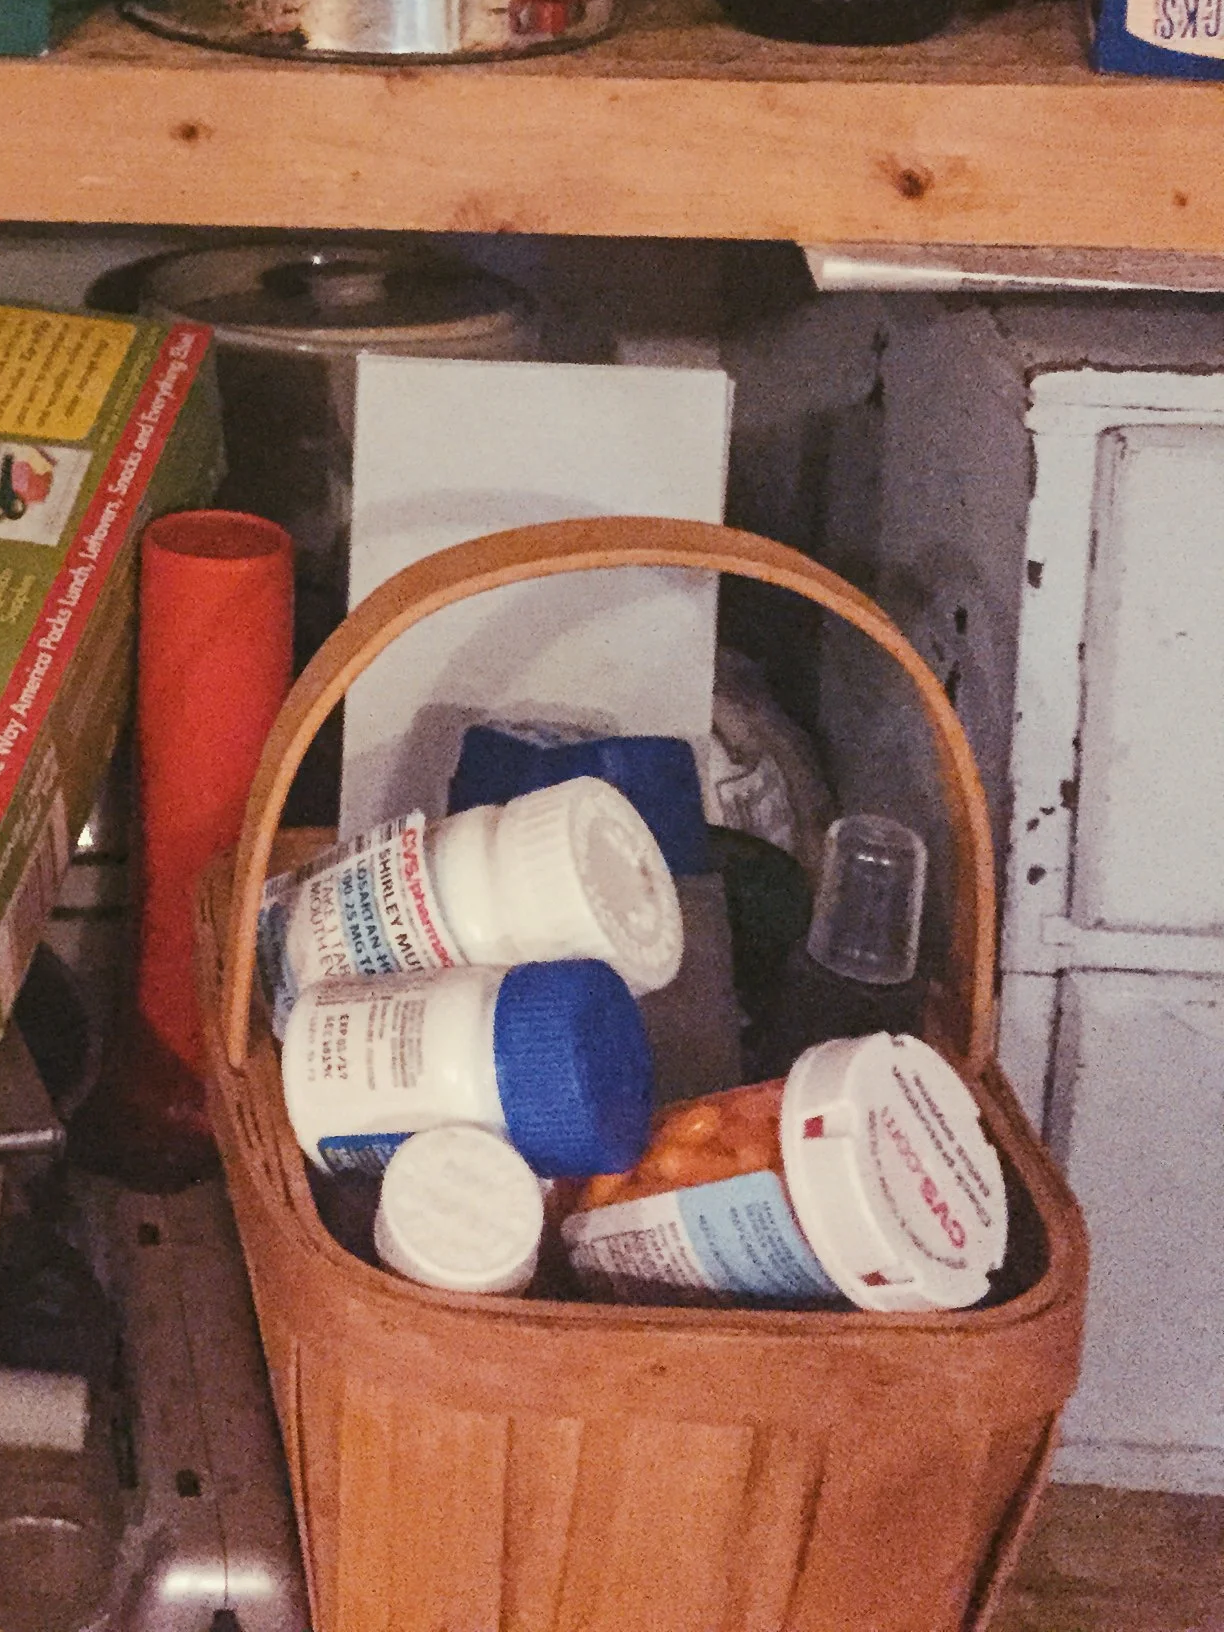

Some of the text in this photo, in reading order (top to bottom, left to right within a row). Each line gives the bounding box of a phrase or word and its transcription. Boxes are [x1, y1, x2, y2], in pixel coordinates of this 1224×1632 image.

[142, 358, 188, 423] Everything
[134, 421, 155, 451] and
[107, 451, 143, 496] Snacks
[79, 498, 122, 561] Leftovers,
[57, 558, 97, 608] Lunch,
[37, 607, 74, 651] Packs
[9, 652, 54, 716] America
[309, 881, 327, 952] MOUTH
[356, 859, 381, 950] LOSARTAN
[378, 847, 403, 927] SHIRLEY
[349, 924, 367, 954] MG
